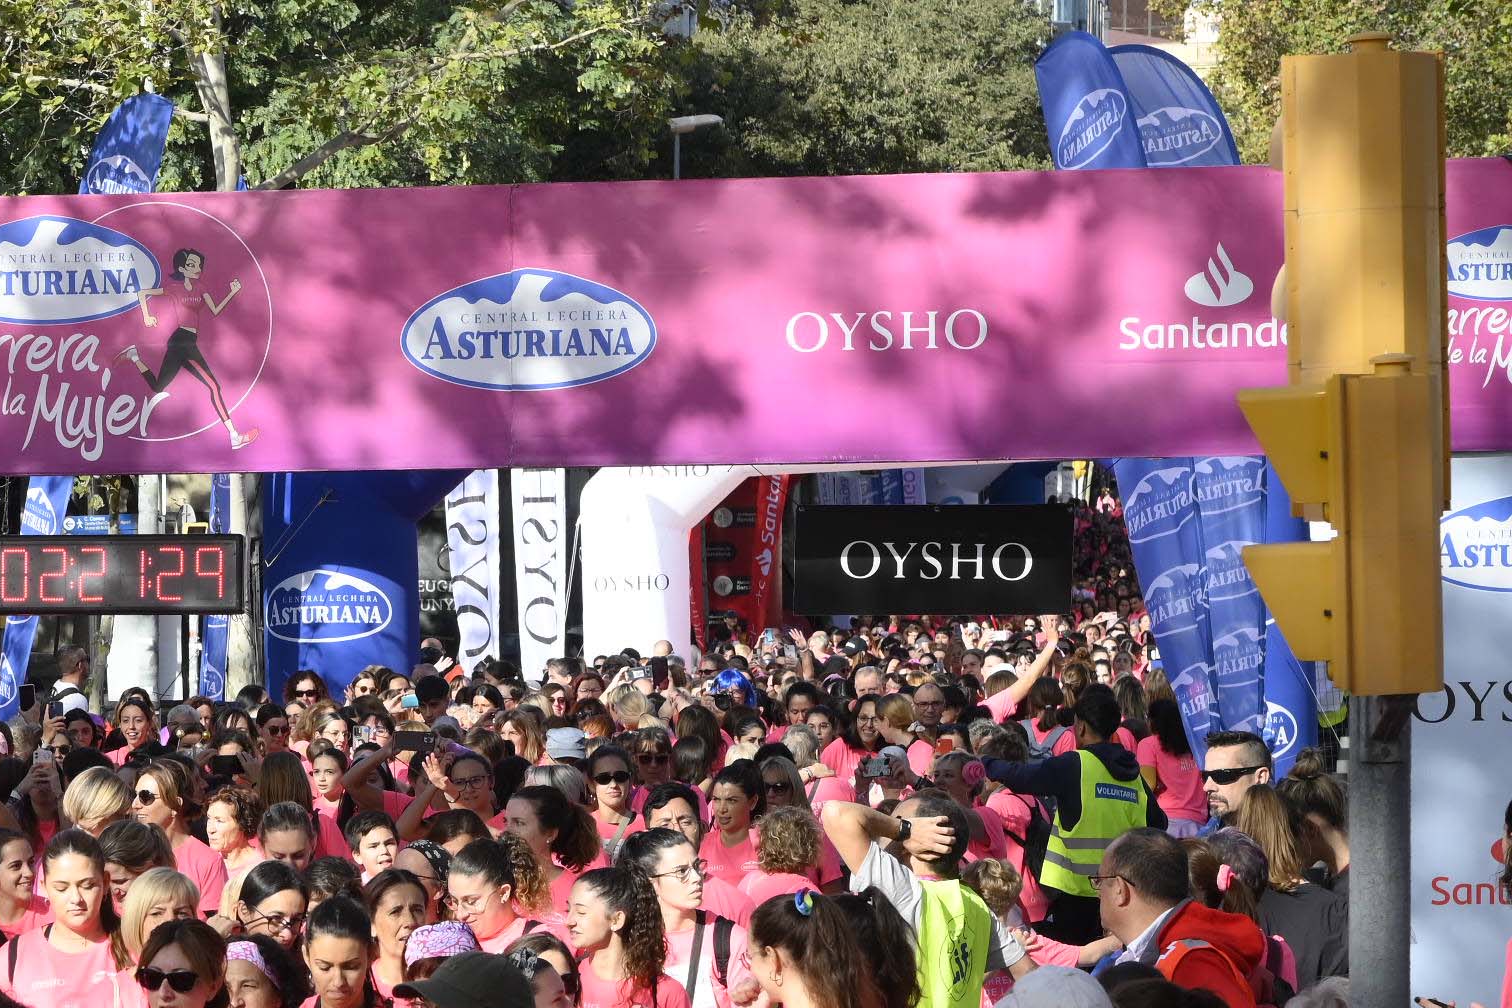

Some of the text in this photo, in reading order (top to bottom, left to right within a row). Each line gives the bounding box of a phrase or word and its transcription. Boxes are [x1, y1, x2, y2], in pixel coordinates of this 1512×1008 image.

[64, 251, 136, 264] LECHERA
[460, 309, 628, 324] CENTRAL LECHERA
[785, 308, 988, 353] OYSHO
[421, 315, 637, 360] ASTURIANA
[1469, 335, 1487, 364] la
[2, 376, 26, 416] la
[21, 367, 171, 462] Mujer
[840, 539, 1033, 582] OYSHO
[594, 573, 670, 592] OYSHO
[282, 593, 379, 603] CENTRAL LECHERA
[269, 599, 383, 627] ASTURIANA
